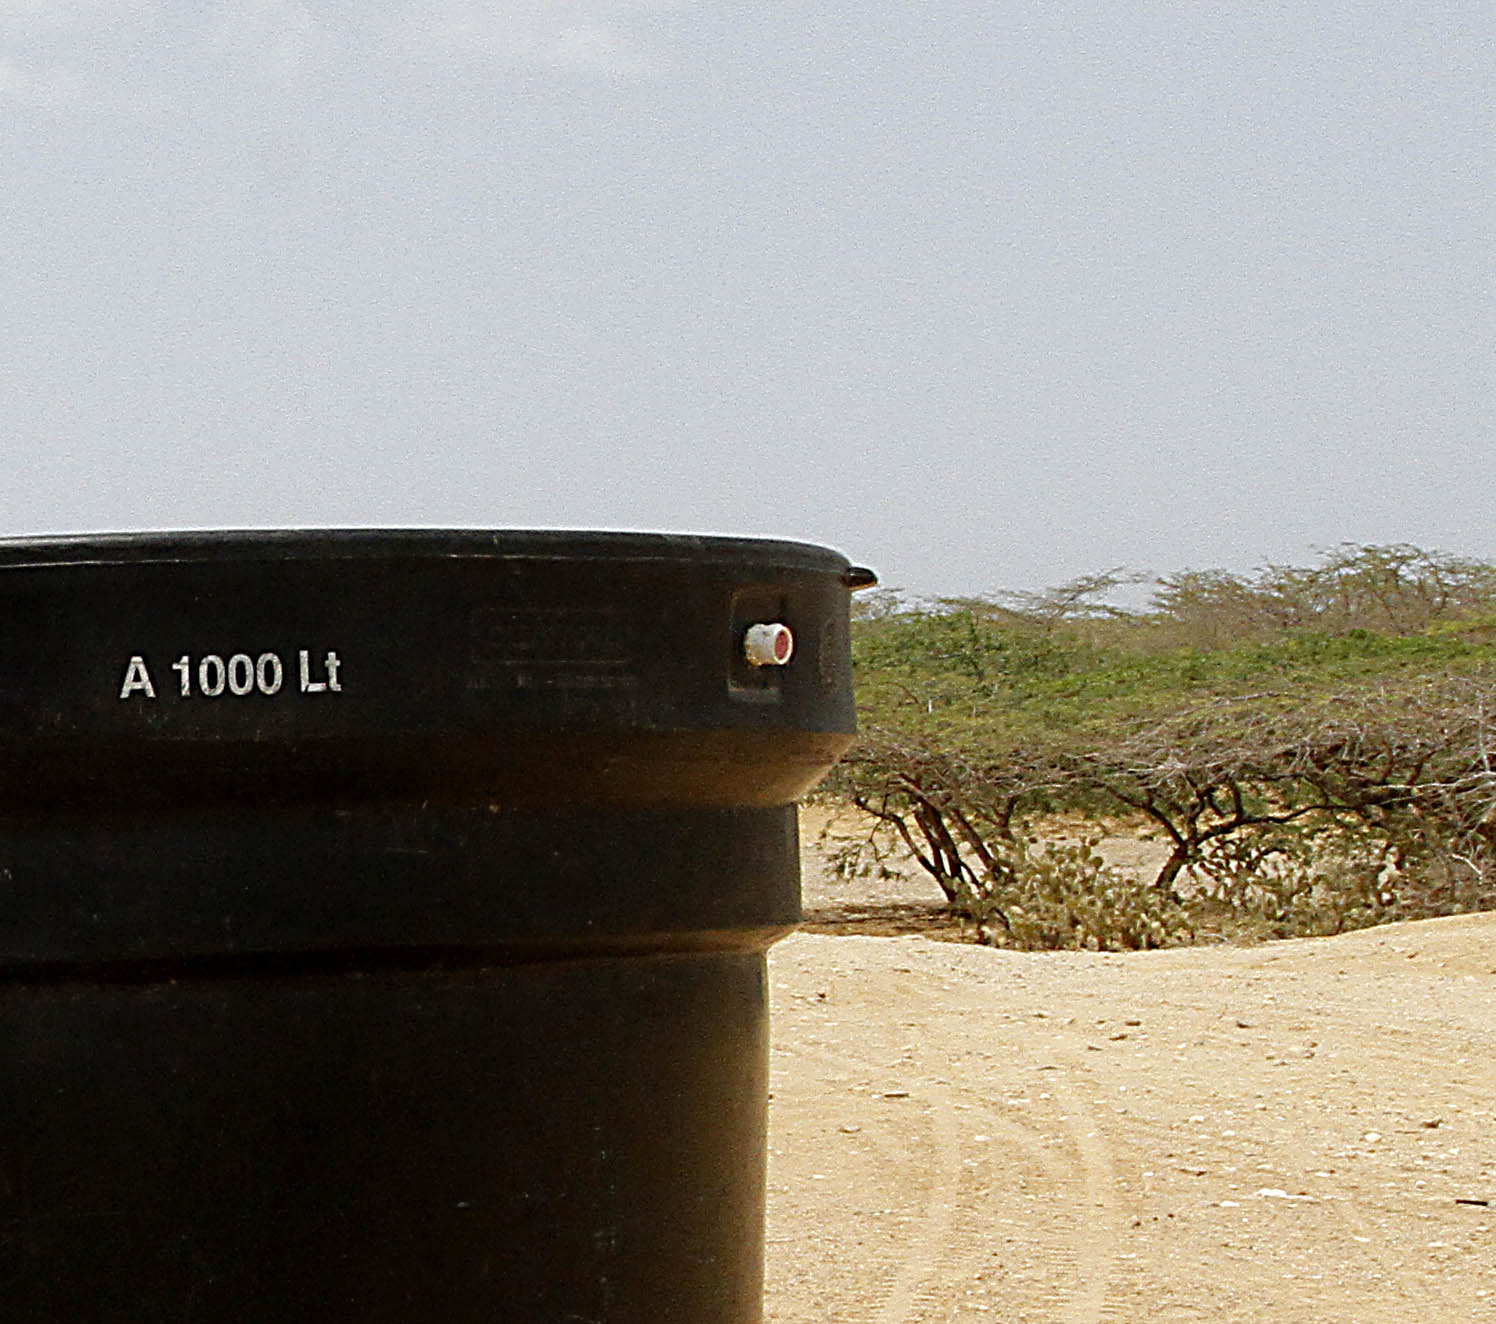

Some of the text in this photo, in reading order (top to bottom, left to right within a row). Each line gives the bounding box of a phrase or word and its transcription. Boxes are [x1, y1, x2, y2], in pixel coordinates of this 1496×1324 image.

[119, 649, 342, 699] A 1000 Lt
